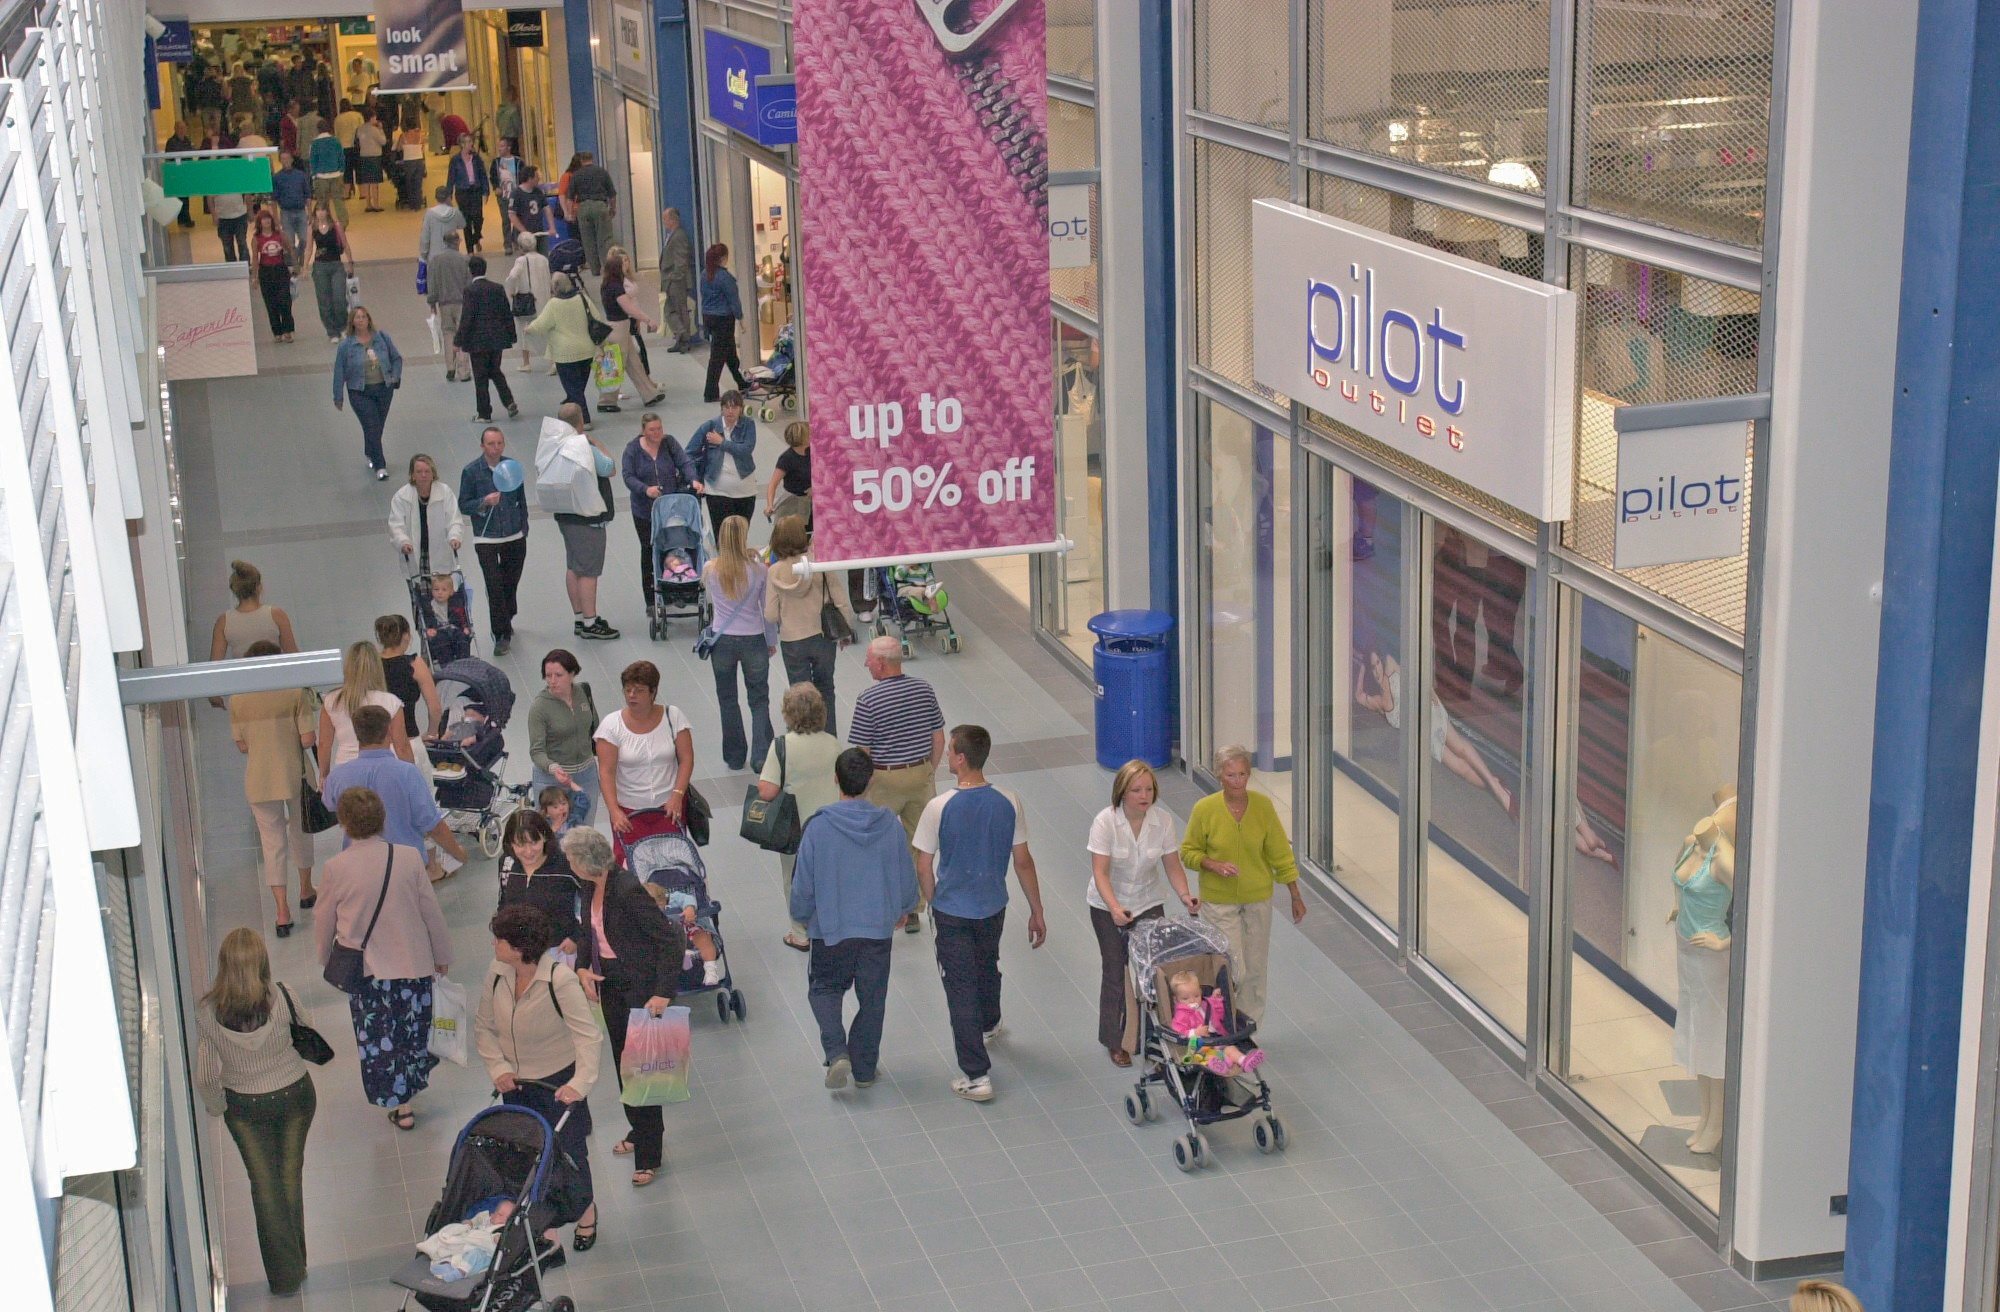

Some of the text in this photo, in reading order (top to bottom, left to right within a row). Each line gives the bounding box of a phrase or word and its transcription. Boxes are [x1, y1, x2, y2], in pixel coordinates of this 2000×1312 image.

[386, 26, 422, 43] look
[389, 49, 458, 74] smart
[529, 200, 539, 215] 3
[1050, 216, 1088, 237] ot
[1307, 263, 1467, 415] pilot
[849, 393, 963, 448] up to
[1313, 368, 1464, 451] outlet
[852, 456, 1035, 514] 50% off
[1622, 475, 1740, 523] pilot
[1627, 506, 1738, 522] outlet
